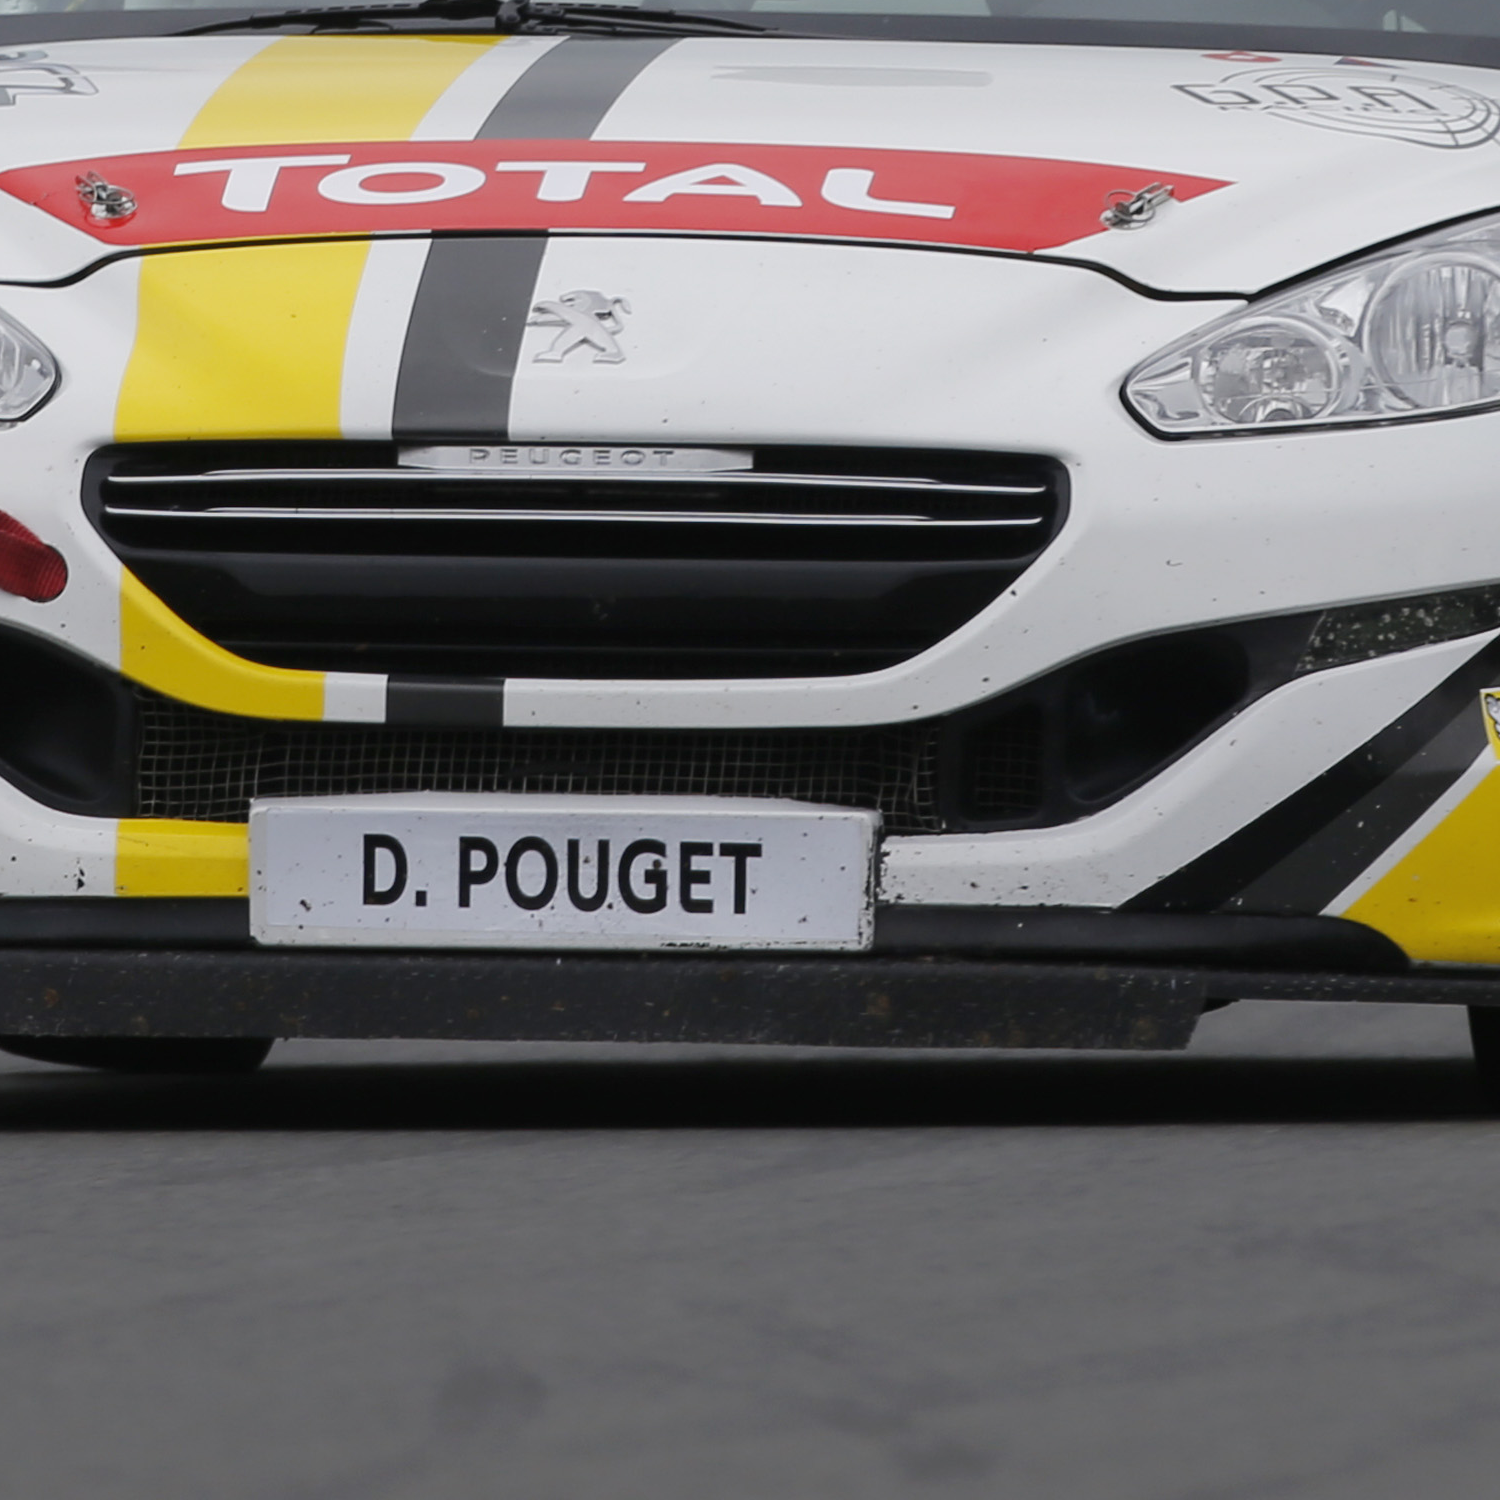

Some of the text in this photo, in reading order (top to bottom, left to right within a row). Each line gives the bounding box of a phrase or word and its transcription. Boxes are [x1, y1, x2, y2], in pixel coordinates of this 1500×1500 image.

[172, 153, 956, 220] TOTAL
[469, 449, 675, 466] PEUGEOT
[361, 833, 763, 915] D. POUGET
